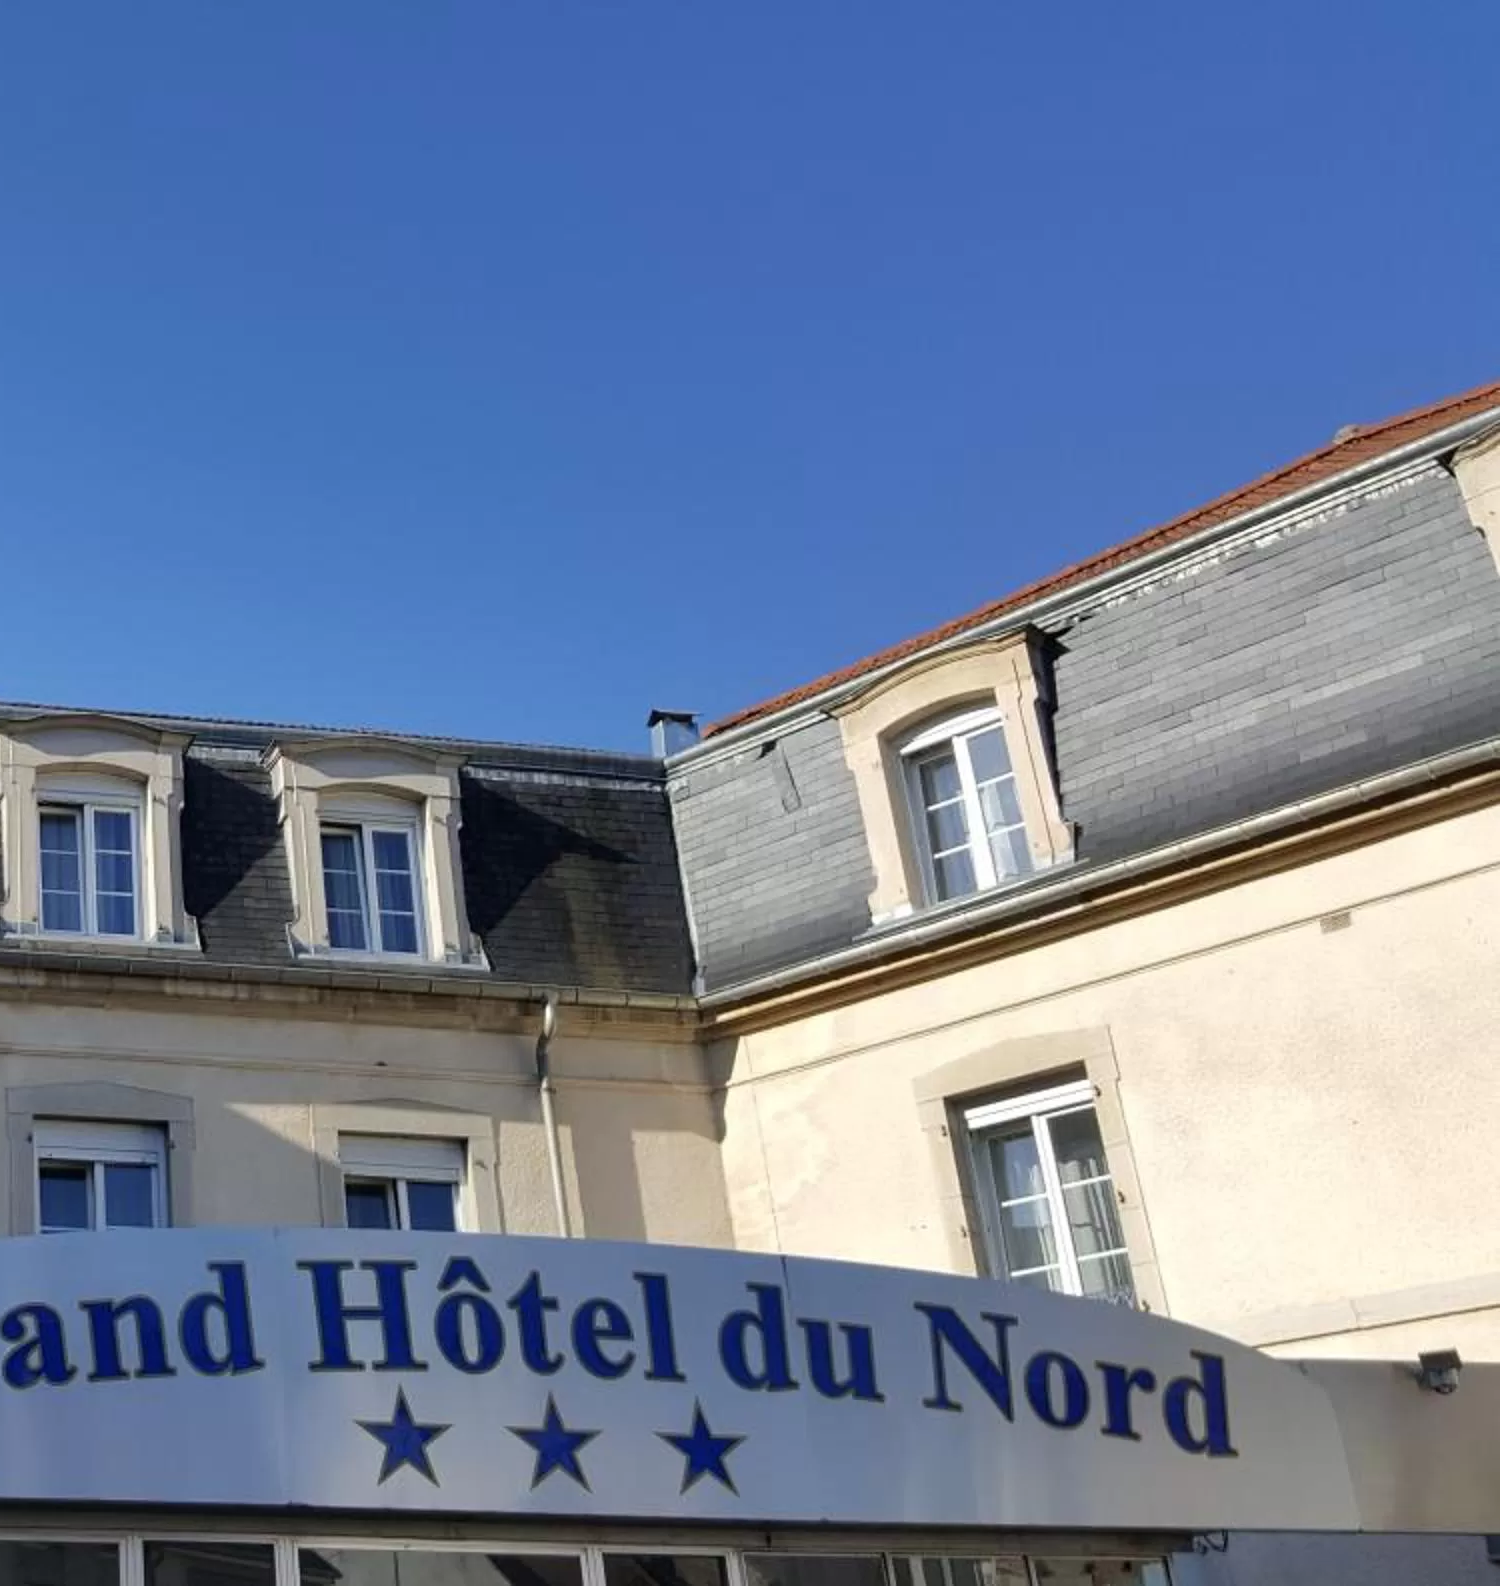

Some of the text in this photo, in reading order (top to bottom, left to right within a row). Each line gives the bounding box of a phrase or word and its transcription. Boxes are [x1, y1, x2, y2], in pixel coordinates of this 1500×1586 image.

[296, 1255, 687, 1383] Hôtel
[717, 1281, 886, 1402] du
[913, 1301, 1240, 1459] Nord
